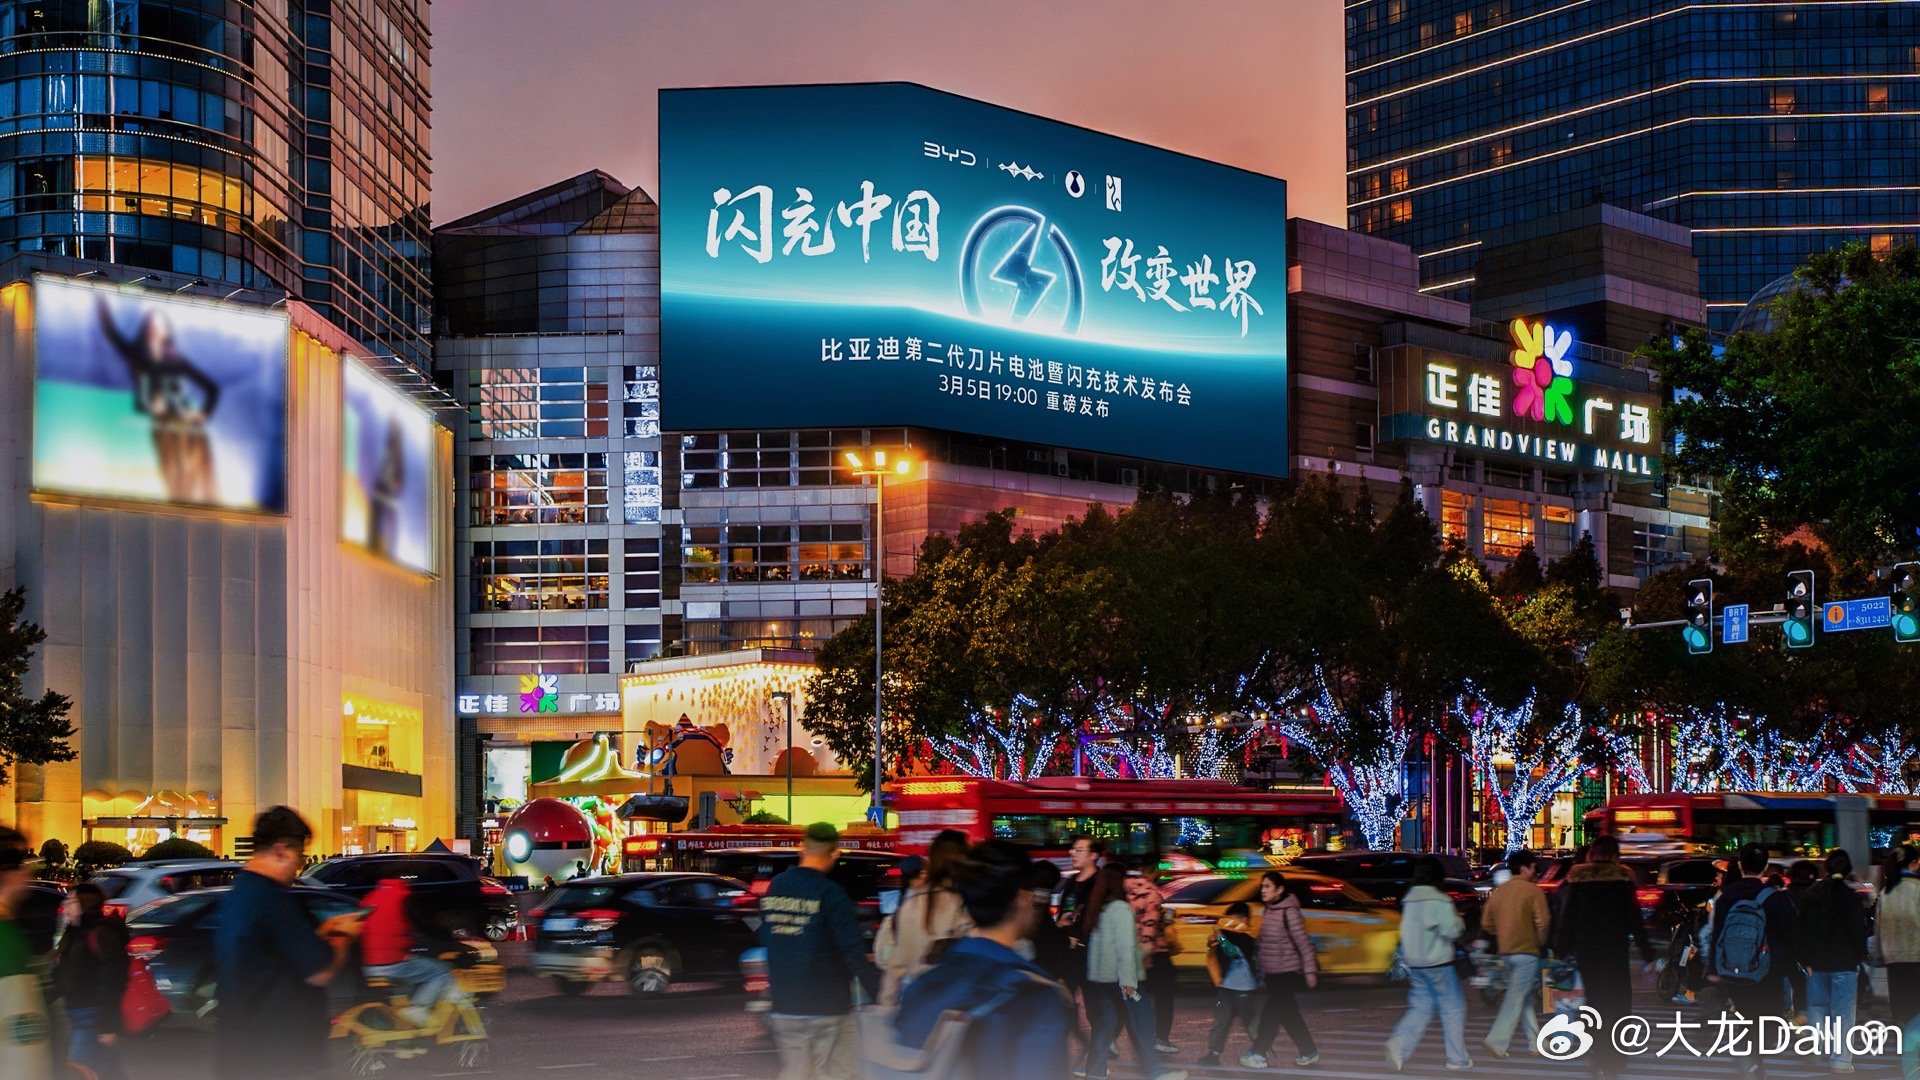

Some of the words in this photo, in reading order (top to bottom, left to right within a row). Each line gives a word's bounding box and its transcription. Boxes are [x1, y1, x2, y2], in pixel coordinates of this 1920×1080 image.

[924, 141, 977, 167] BYD
[705, 180, 940, 264] 闪充中国
[1101, 236, 1264, 338] 改变世界
[820, 336, 1192, 406] 比亚迪第二代刀片电池暨闪充技术发布会
[1046, 390, 1110, 418] 重磅发布
[1428, 363, 1500, 416] 正佳
[1584, 398, 1650, 444] 广场
[1428, 418, 1576, 462] GRANDVIEW
[1594, 449, 1651, 475] MALL
[1729, 607, 1744, 617] BRT
[1861, 601, 1884, 612] 5022
[459, 694, 509, 713] 正佳
[569, 693, 621, 712] 广场
